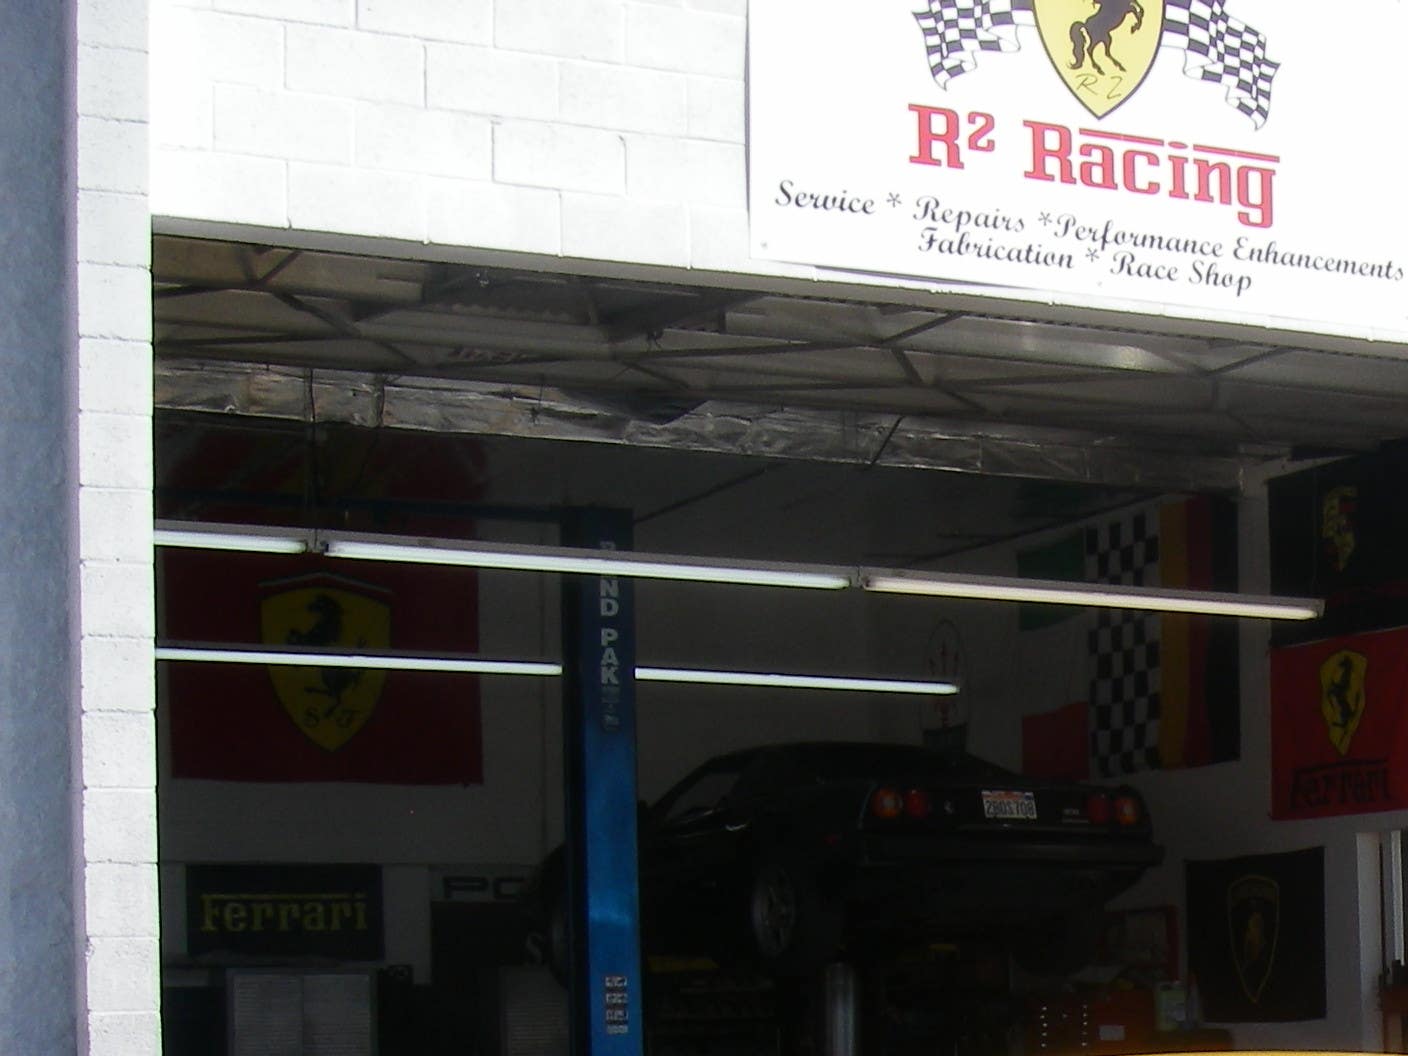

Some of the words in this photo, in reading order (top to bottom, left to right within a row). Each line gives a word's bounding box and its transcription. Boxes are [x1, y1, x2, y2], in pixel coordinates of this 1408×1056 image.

[1023, 119, 1280, 228] Racing
[775, 180, 876, 214] Service
[913, 195, 1025, 233] Repairs
[1054, 213, 1223, 257] Performance
[1233, 236, 1404, 281] Enhancements
[918, 226, 1074, 269] Fabrication
[1110, 250, 1179, 281] Race
[1188, 259, 1252, 297] Shop
[200, 891, 367, 933] Ferrari
